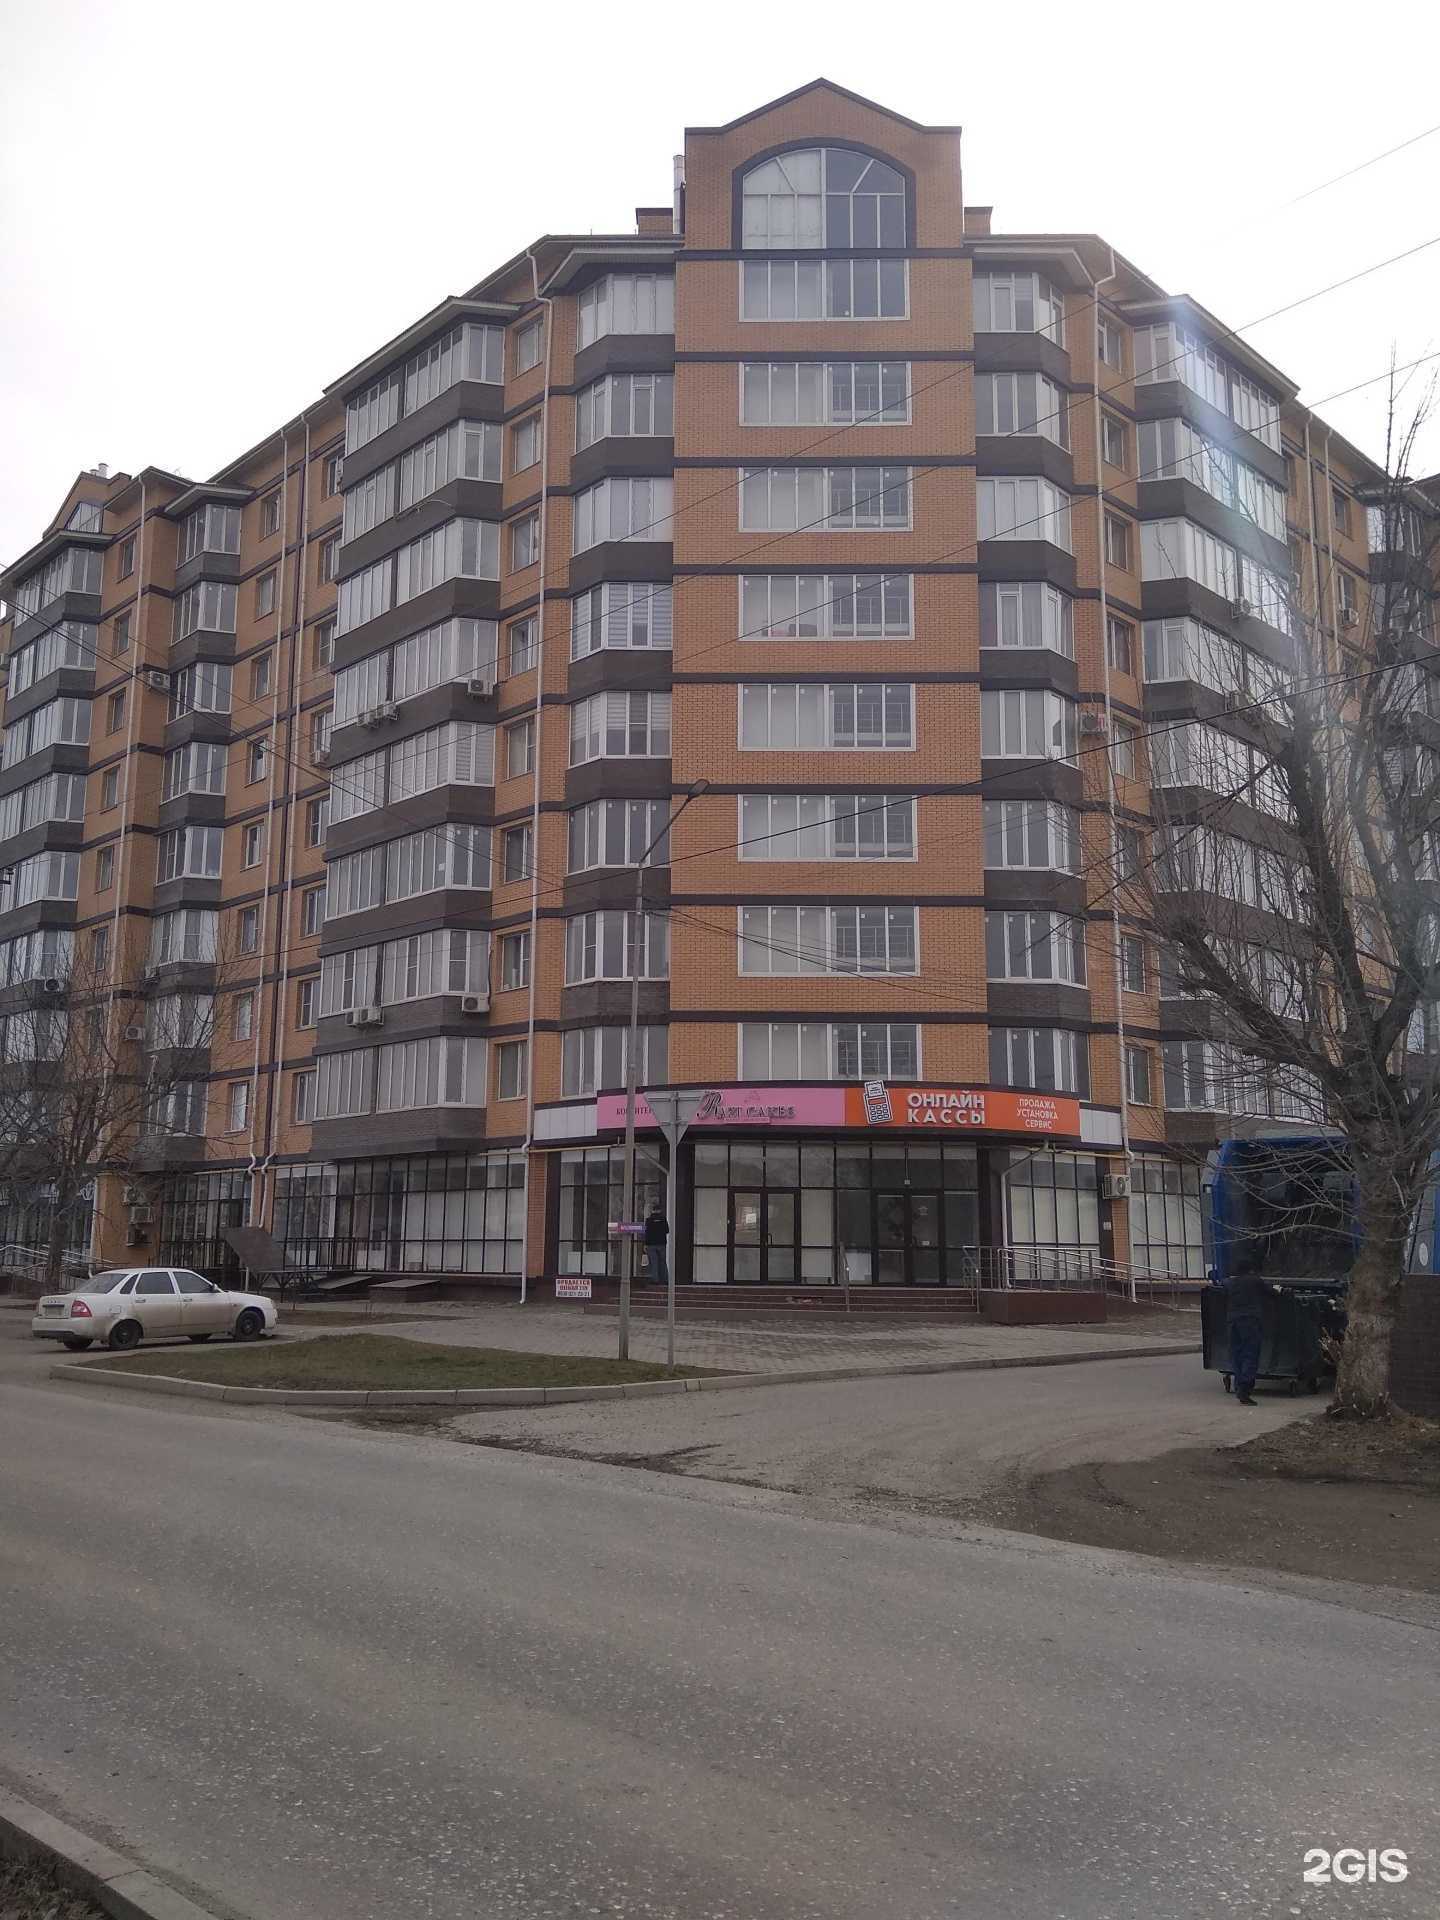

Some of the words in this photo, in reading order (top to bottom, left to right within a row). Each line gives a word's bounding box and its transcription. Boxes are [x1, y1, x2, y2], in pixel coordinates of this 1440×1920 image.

[907, 1090, 985, 1109] ОНЛАЙН
[1019, 1098, 1056, 1110] ПРОДАЖА
[907, 1108, 985, 1124] КАССЫ
[1016, 1107, 1059, 1120] УСТАНОВКА
[1025, 1118, 1053, 1130] СЕРВИС
